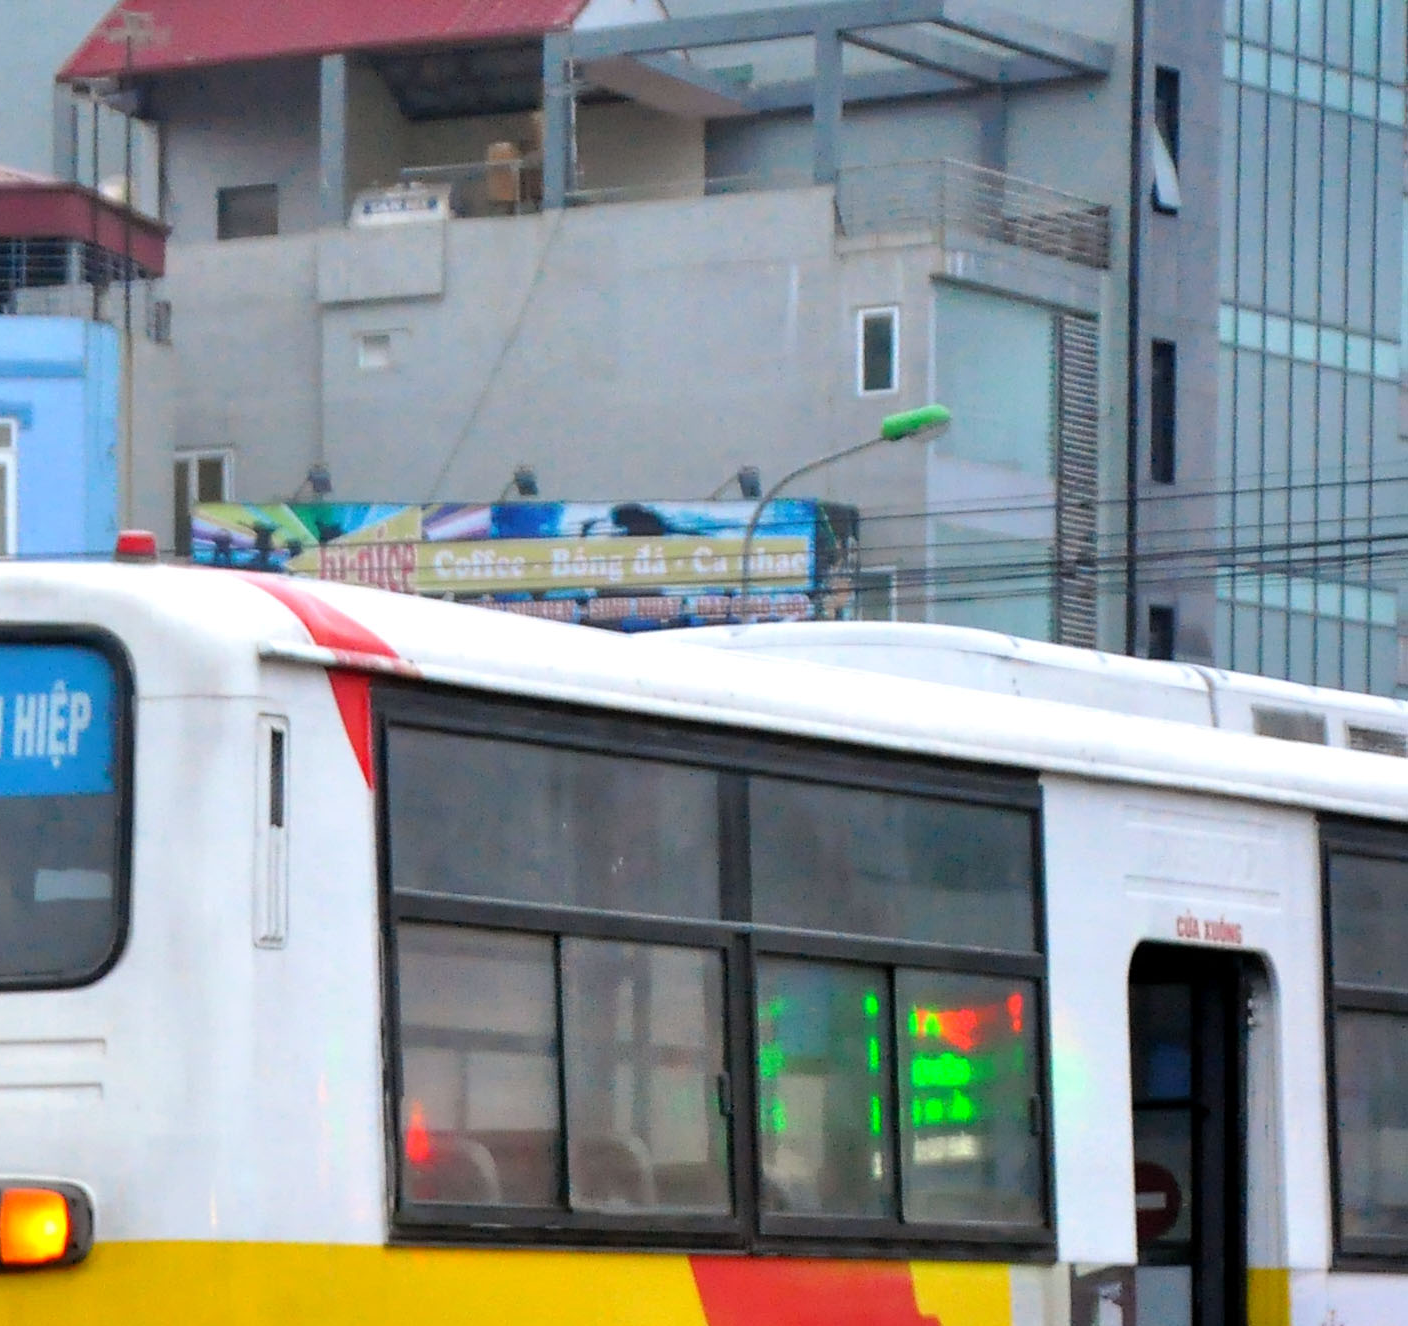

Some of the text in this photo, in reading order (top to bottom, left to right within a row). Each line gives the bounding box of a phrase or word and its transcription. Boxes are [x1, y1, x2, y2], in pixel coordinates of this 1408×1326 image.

[435, 549, 527, 579] Coffee
[550, 546, 623, 582] Bóng
[633, 543, 667, 576] đá
[692, 546, 728, 573] Ca
[12, 680, 92, 769] HIỆP
